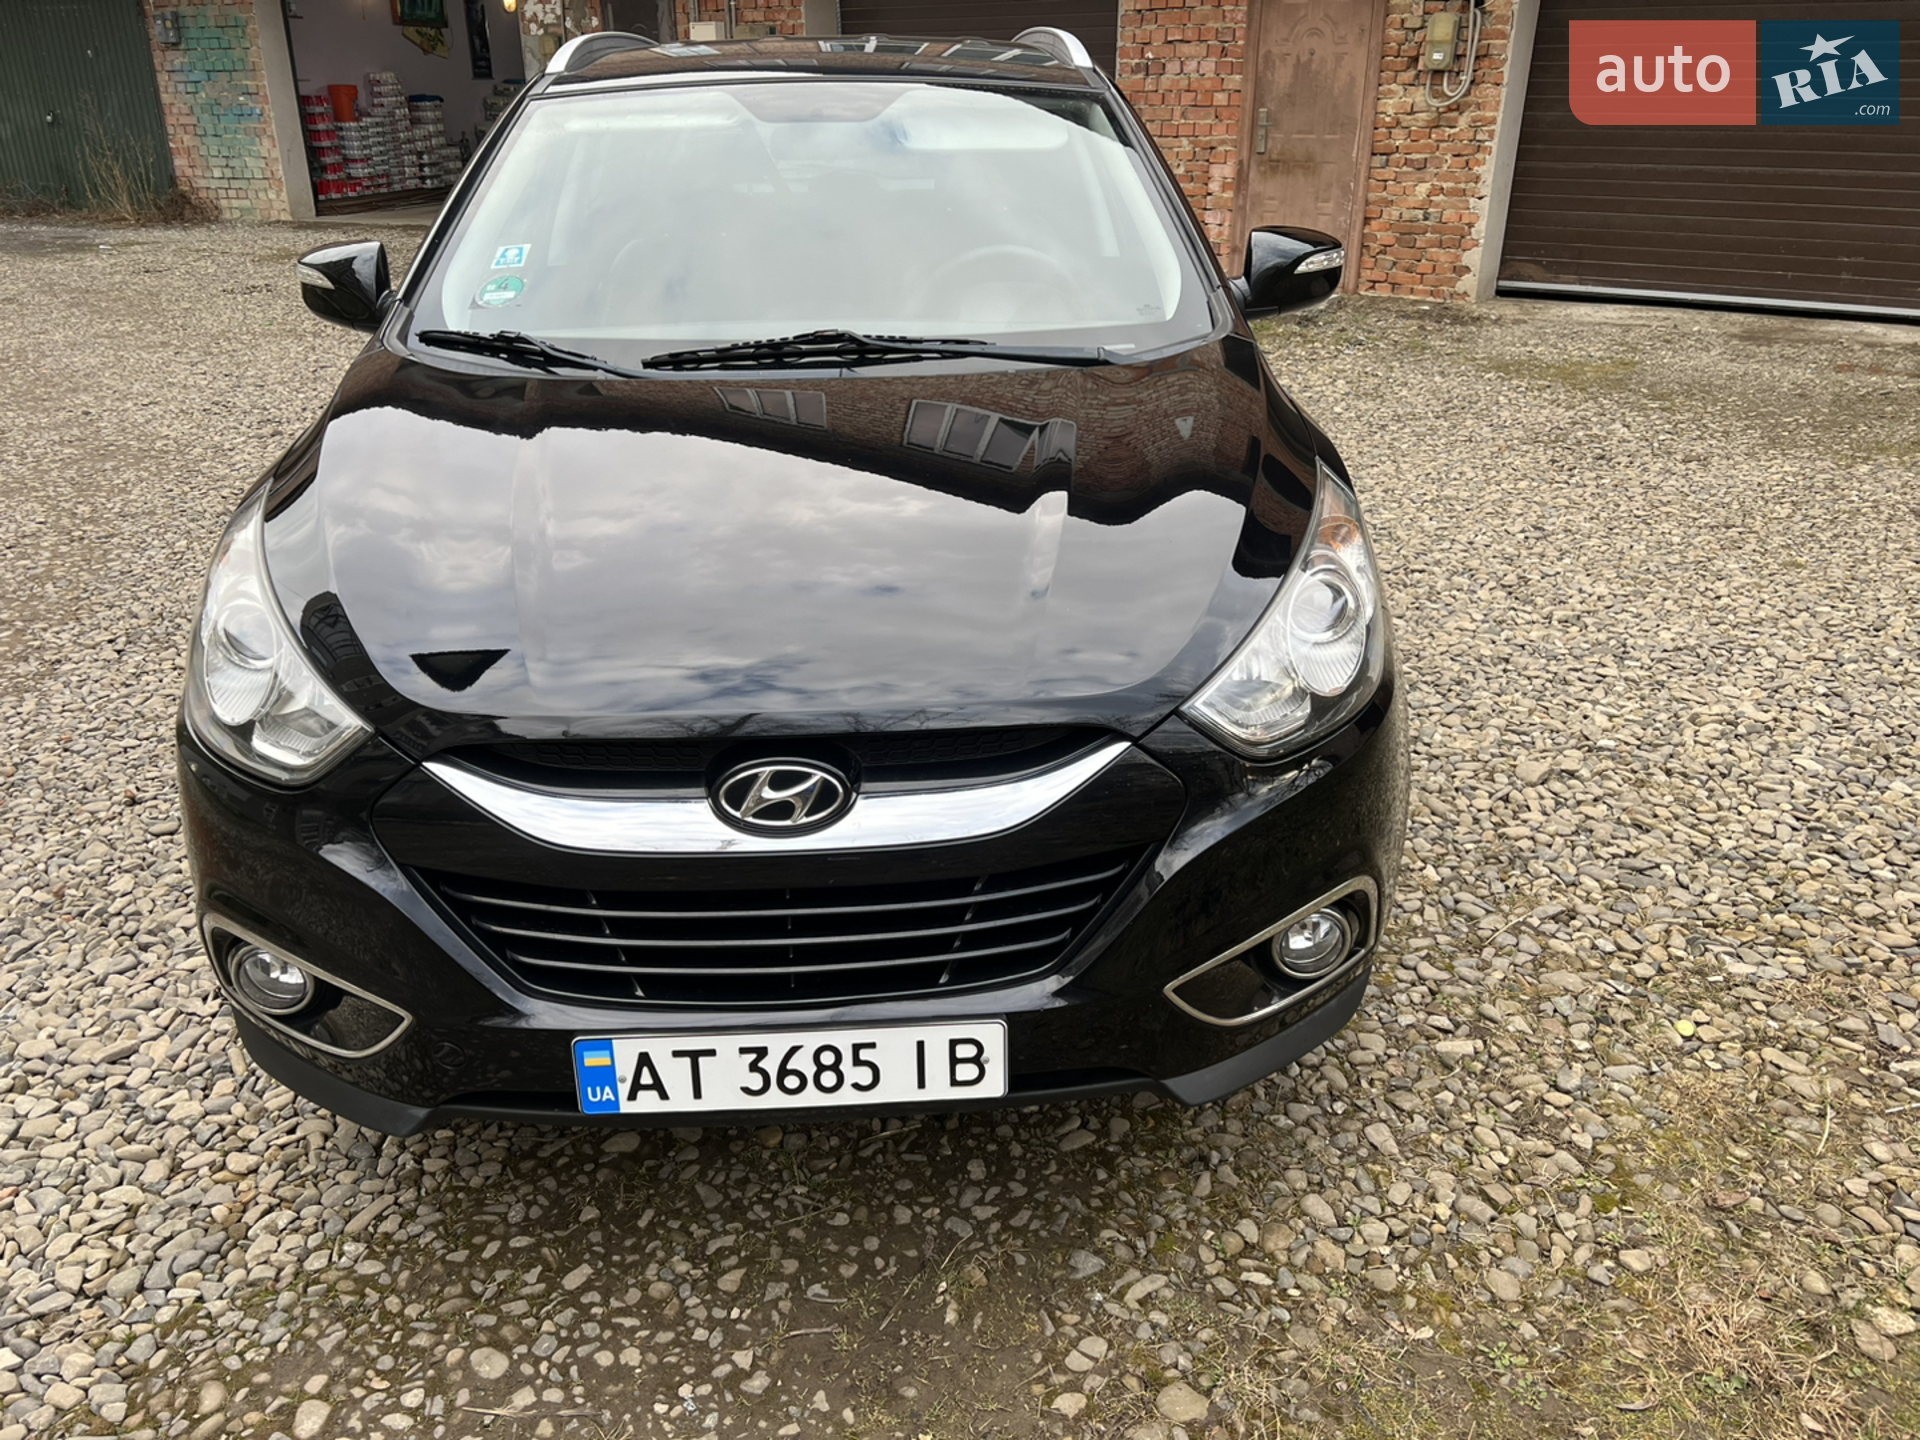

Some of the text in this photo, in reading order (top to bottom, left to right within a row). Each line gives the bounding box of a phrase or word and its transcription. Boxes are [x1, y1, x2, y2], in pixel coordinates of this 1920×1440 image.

[626, 1038, 986, 1102] AT 3685 IB
[587, 1088, 615, 1103] UA
